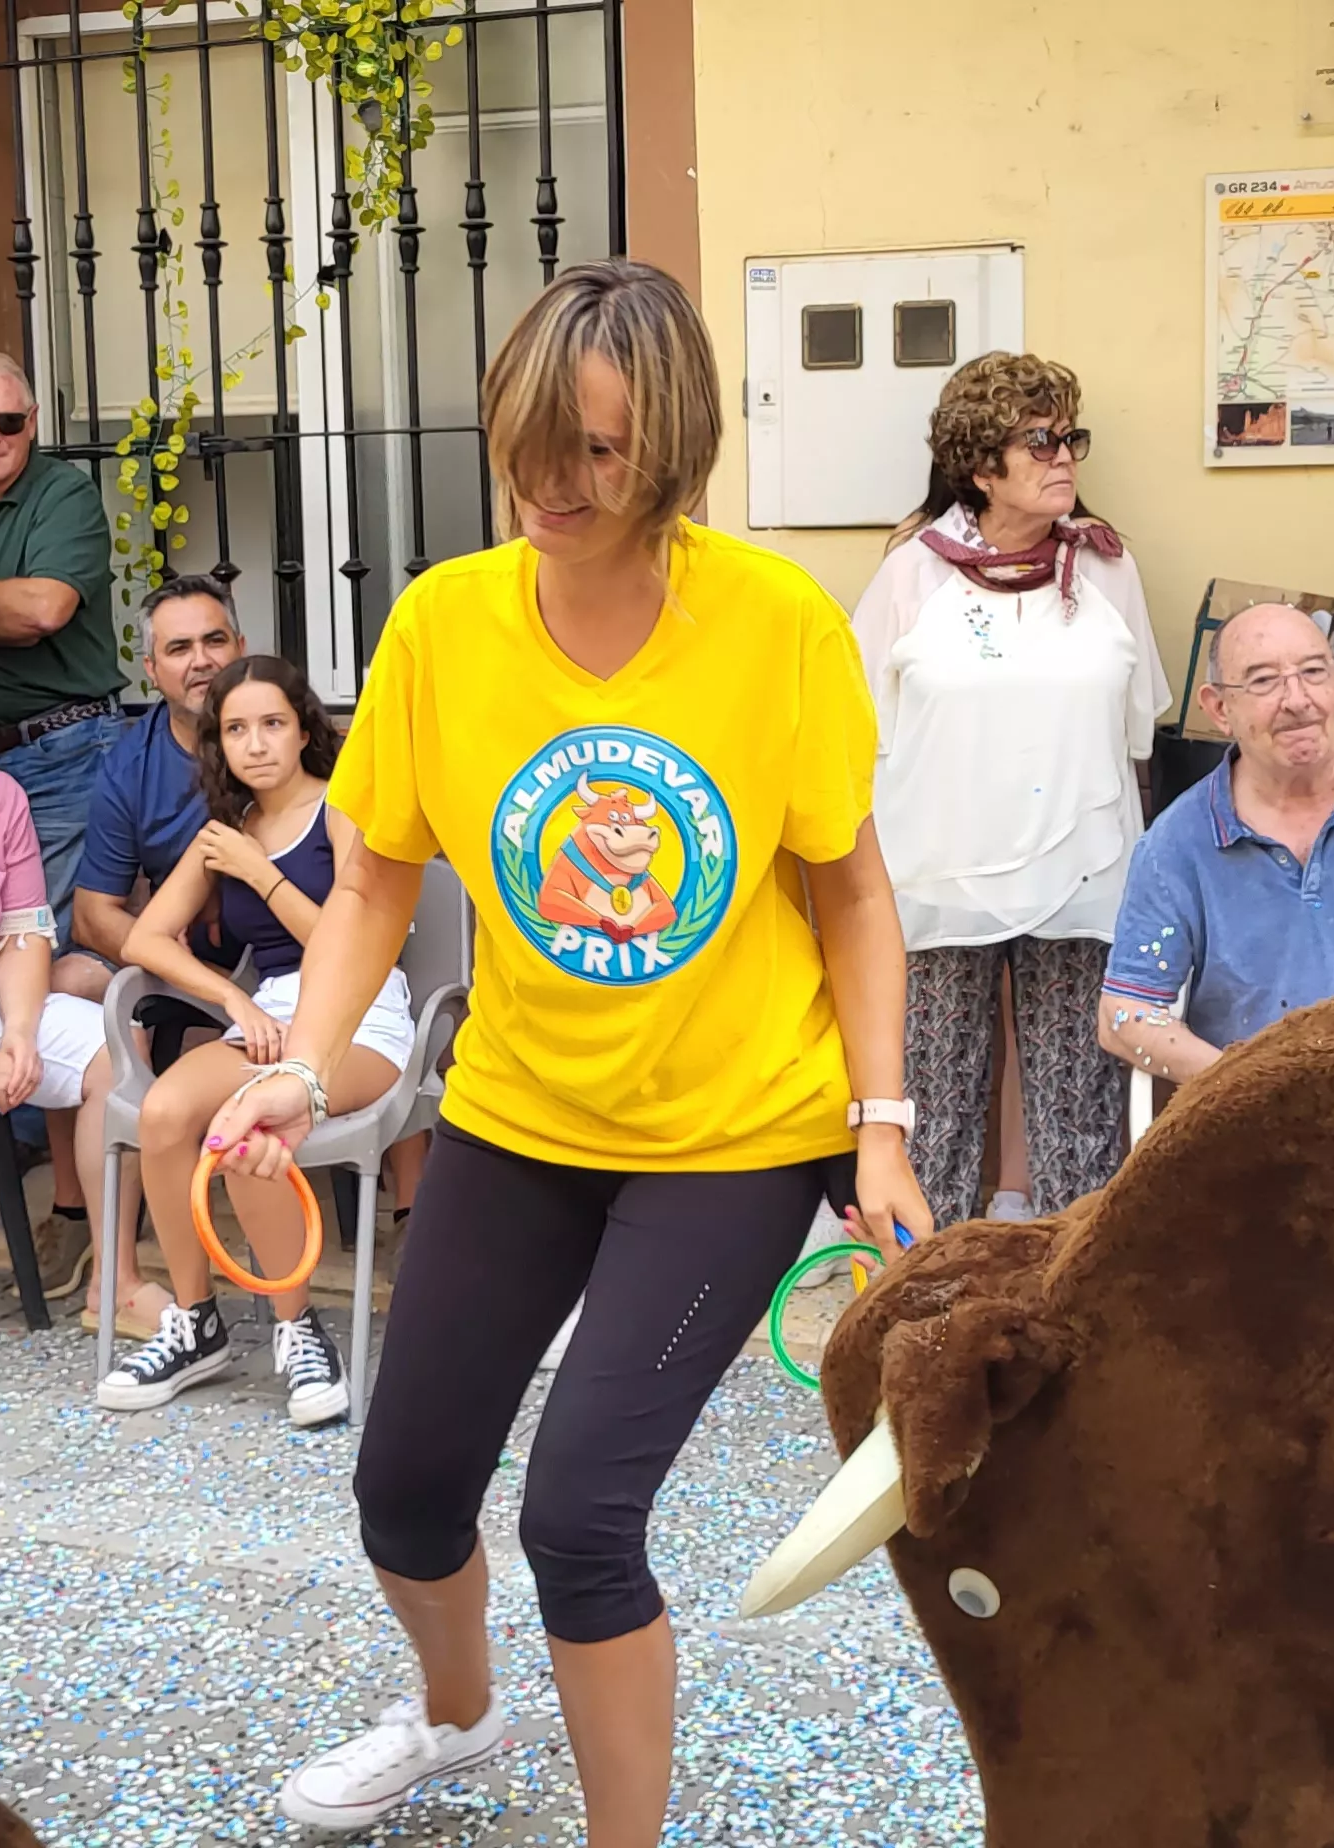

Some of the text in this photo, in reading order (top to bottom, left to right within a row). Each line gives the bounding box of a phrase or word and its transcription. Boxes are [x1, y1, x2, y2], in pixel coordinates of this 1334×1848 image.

[1228, 182, 1248, 194] GR
[1250, 181, 1277, 193] 234
[502, 739, 725, 858] ALMUDEVAR
[550, 925, 674, 977] PRIX
